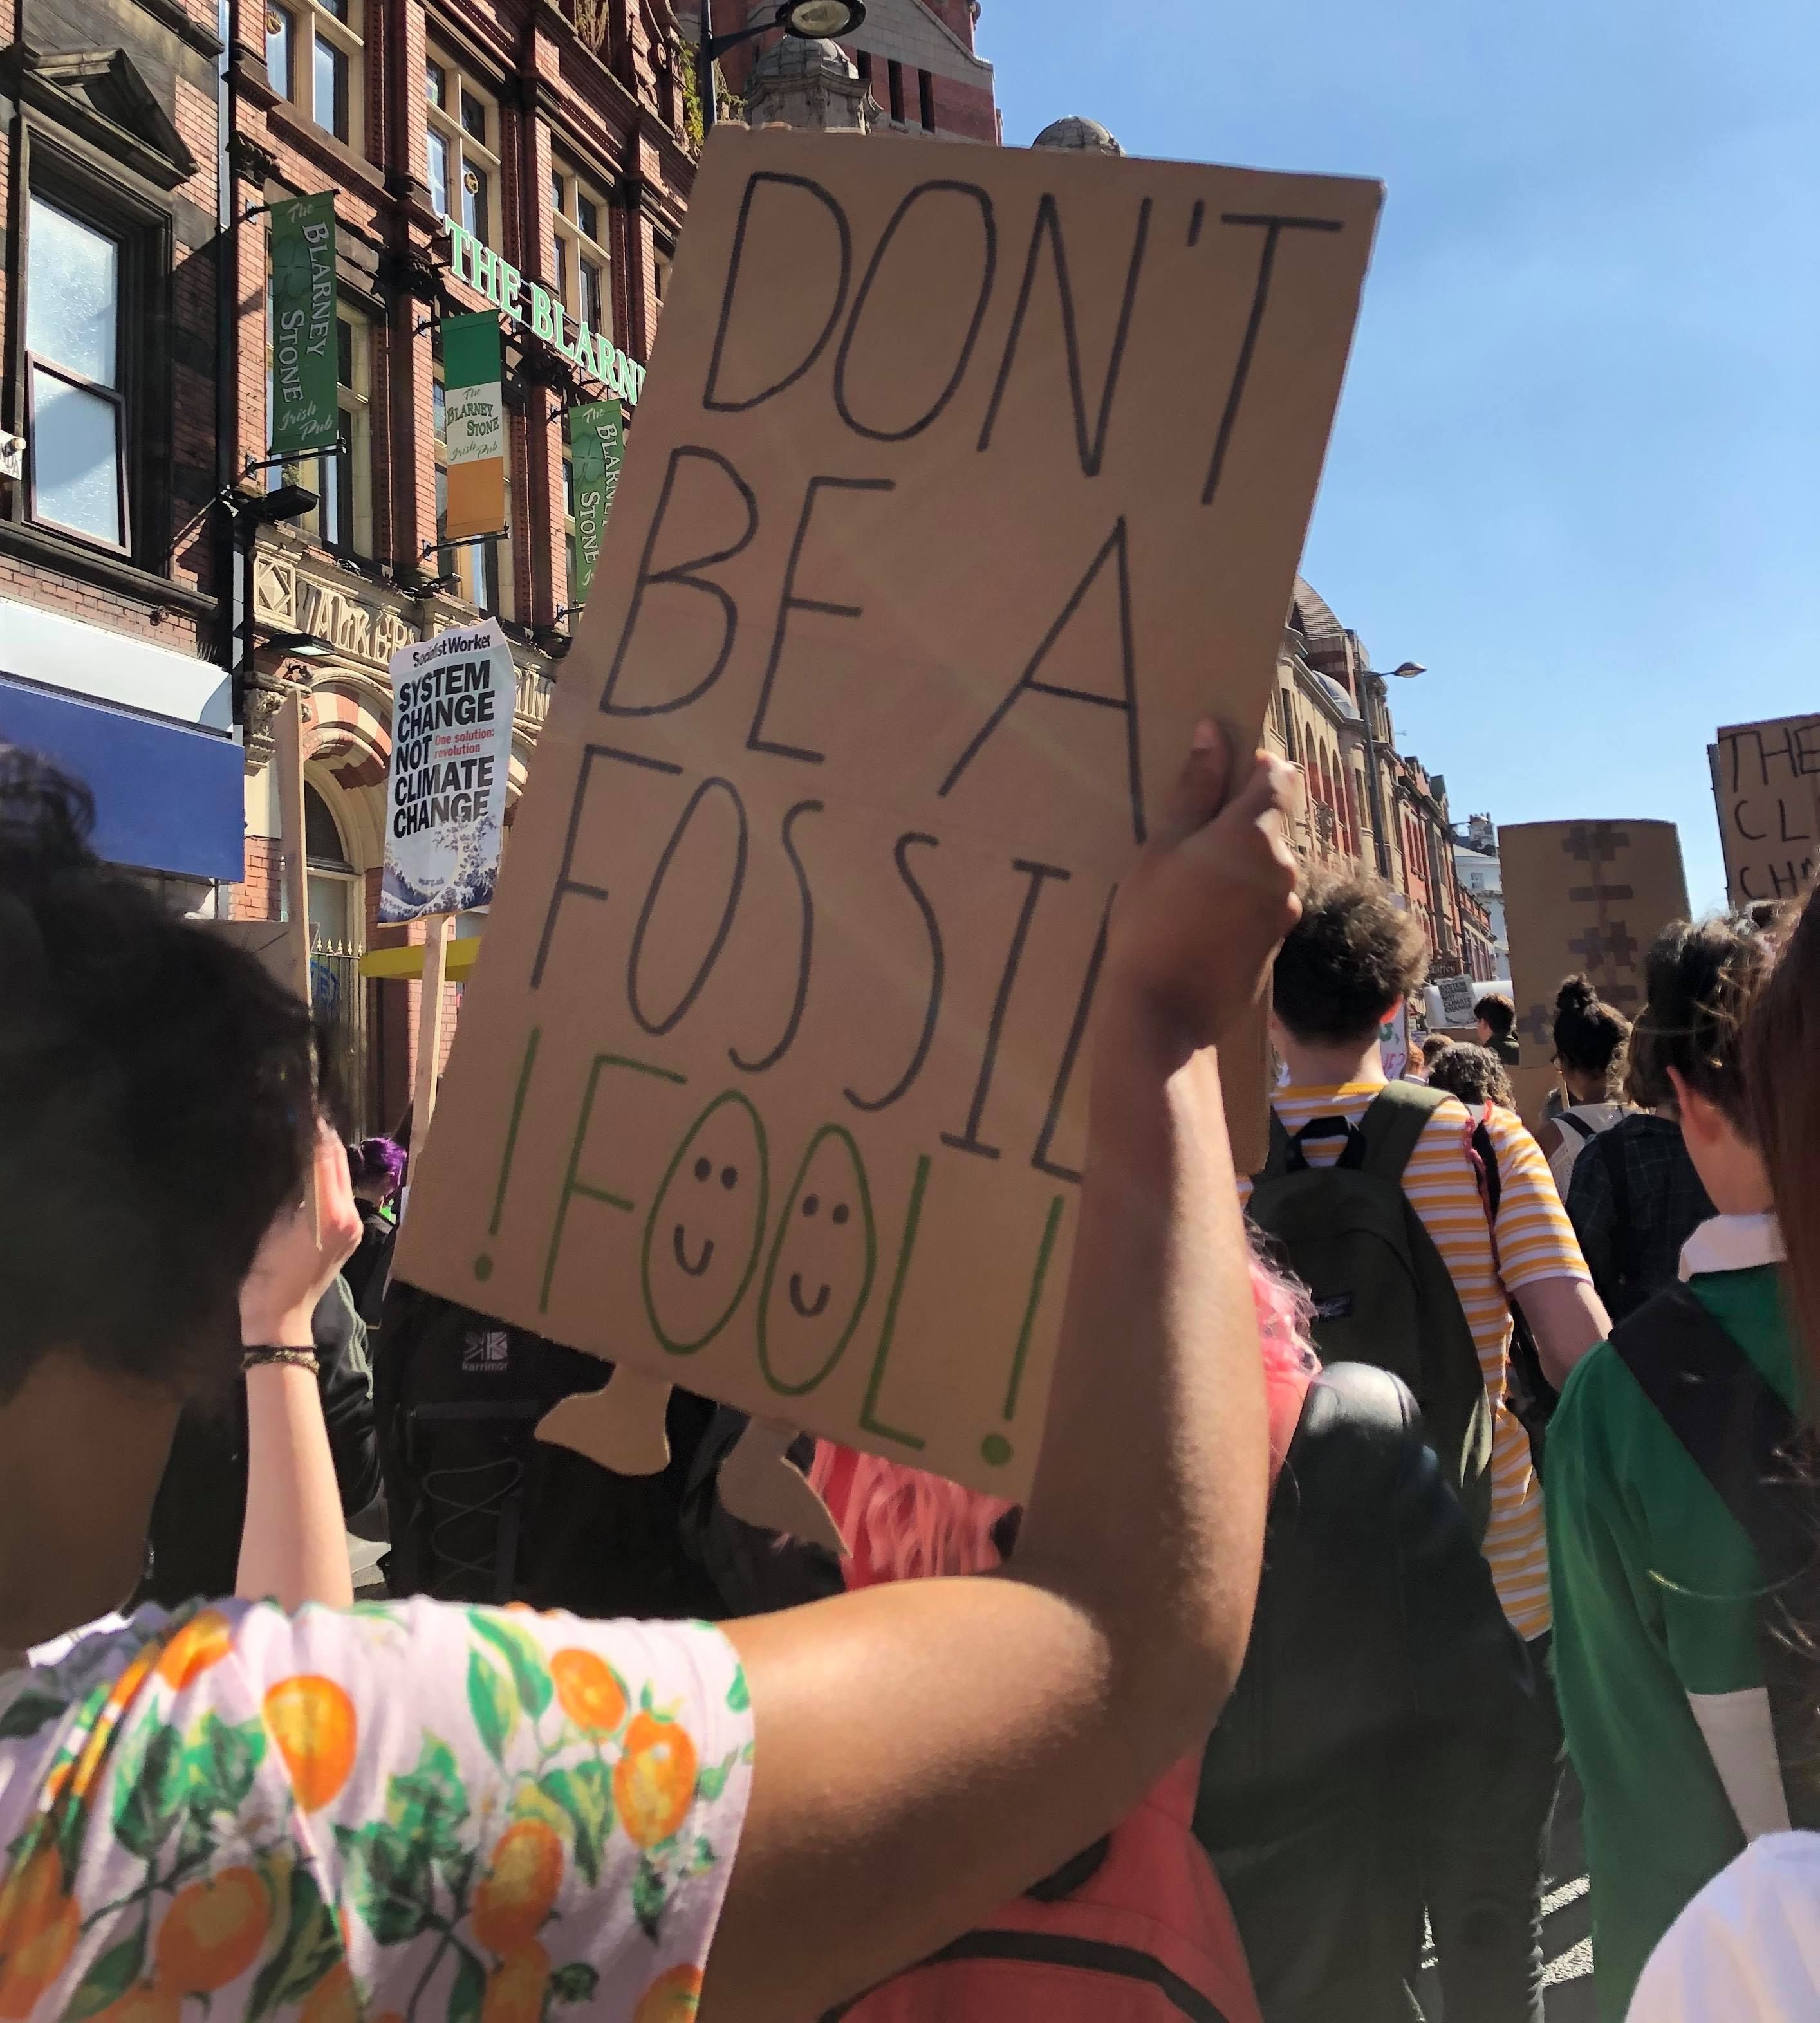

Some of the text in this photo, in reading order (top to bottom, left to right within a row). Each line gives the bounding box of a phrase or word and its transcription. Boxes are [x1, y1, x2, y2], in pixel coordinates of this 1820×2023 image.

[288, 202, 313, 223] The
[302, 221, 331, 356] BLARNEY
[443, 214, 646, 407] THE BLARN
[278, 309, 305, 403] STONE
[703, 172, 1344, 505] DON'T
[279, 400, 316, 430] Irish
[447, 402, 494, 427] BLARNEY
[463, 388, 481, 400] The
[583, 407, 605, 423] The
[299, 414, 333, 441] Pub
[467, 416, 499, 437] STONE
[450, 440, 498, 461] Irish Pub
[596, 422, 620, 527] BLARN
[580, 491, 600, 564] STONE
[599, 445, 1147, 845] BE A
[398, 659, 491, 712] SYSTEM
[398, 690, 496, 743] CHANGE
[434, 728, 495, 746] One solution:
[396, 734, 433, 775] NOT
[434, 743, 481, 759] revolution
[1718, 722, 1820, 793] THE
[395, 755, 495, 807] CLIMATE
[393, 789, 490, 838] CHANGE
[1734, 799, 1820, 842] CL
[531, 743, 1118, 1185] FOSSIL
[462, 1362, 508, 1372] karrimor
